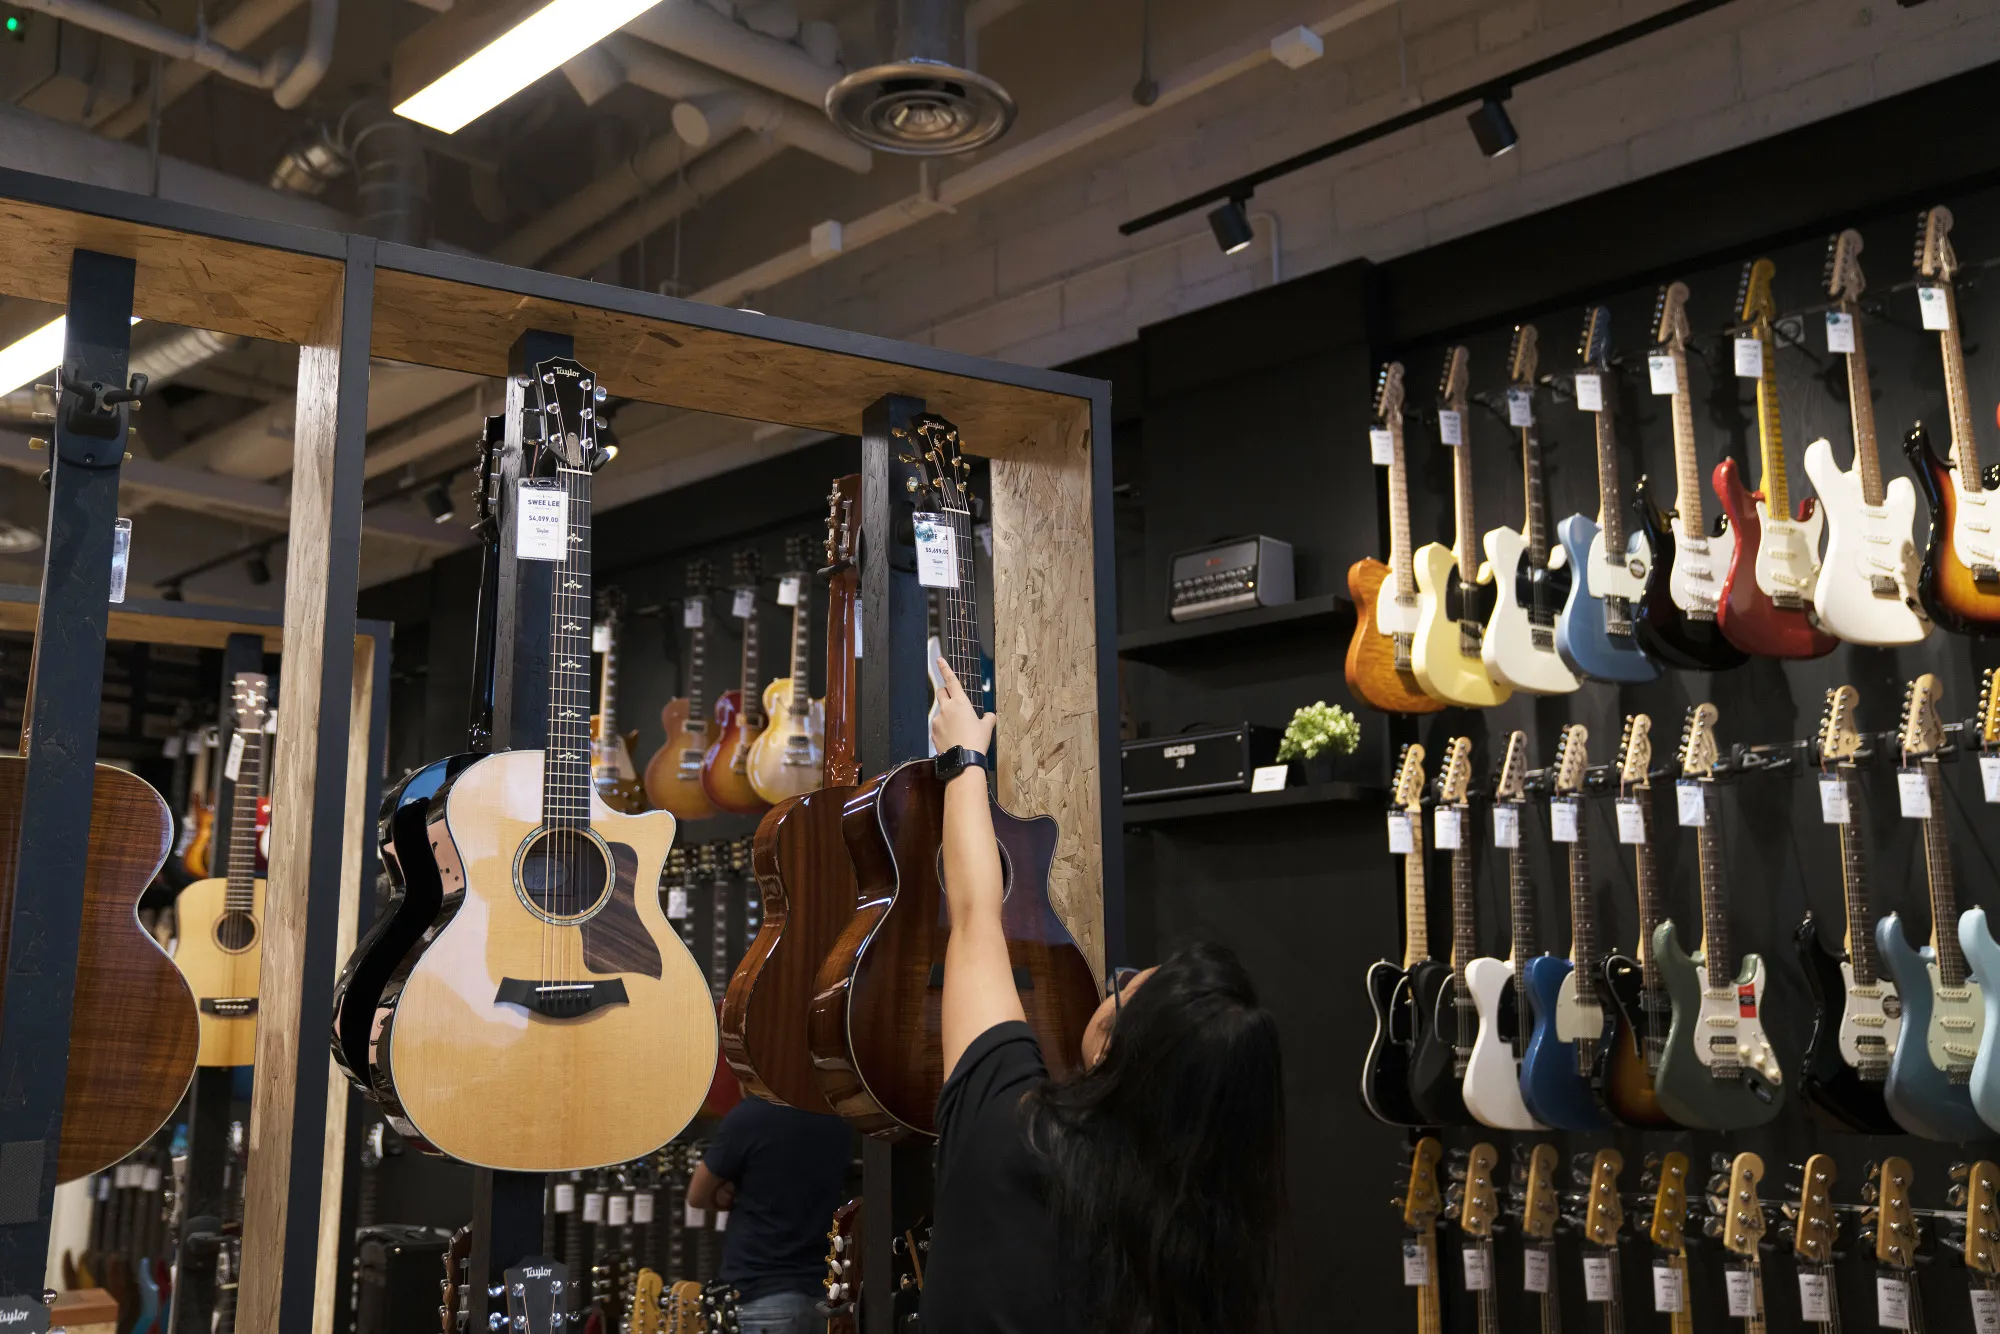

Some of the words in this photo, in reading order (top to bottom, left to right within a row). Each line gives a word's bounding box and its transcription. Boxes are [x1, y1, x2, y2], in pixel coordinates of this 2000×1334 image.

[553, 366, 580, 378] Taylor
[923, 420, 945, 430] Taylor
[1164, 743, 1196, 758] BOSS
[522, 1266, 552, 1279] Taylor
